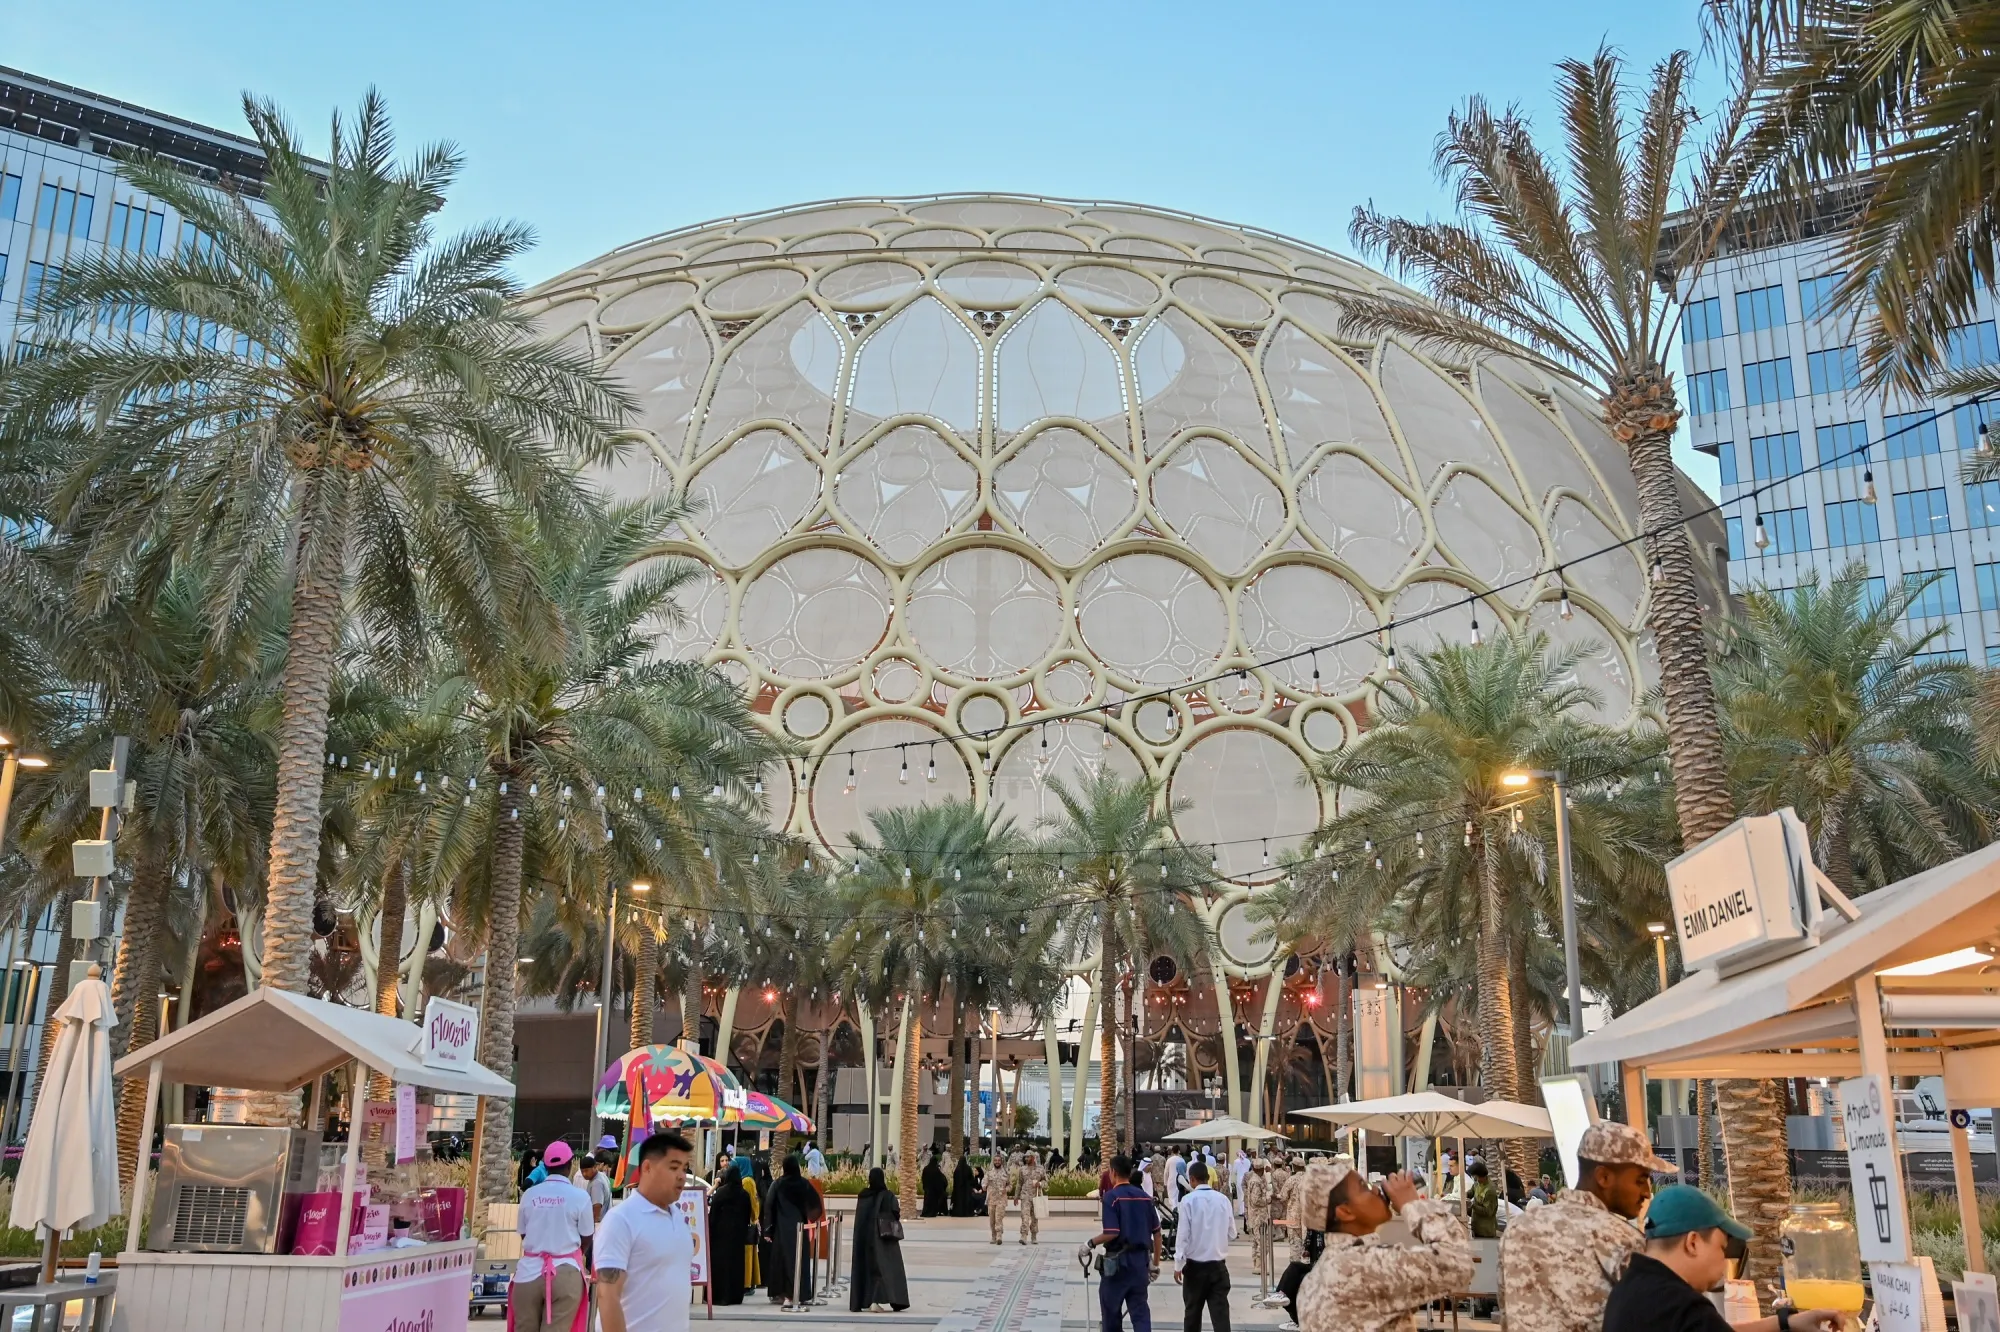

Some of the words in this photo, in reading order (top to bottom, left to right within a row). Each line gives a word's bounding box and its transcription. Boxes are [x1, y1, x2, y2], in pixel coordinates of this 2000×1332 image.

[1683, 908, 1709, 939] EMM
[1708, 888, 1753, 928] DANIEL
[431, 1012, 471, 1050] Floozie
[532, 1195, 565, 1207] Floozie
[1877, 1272, 1895, 1289] KARAK
[1895, 1278, 1911, 1294] CHAI
